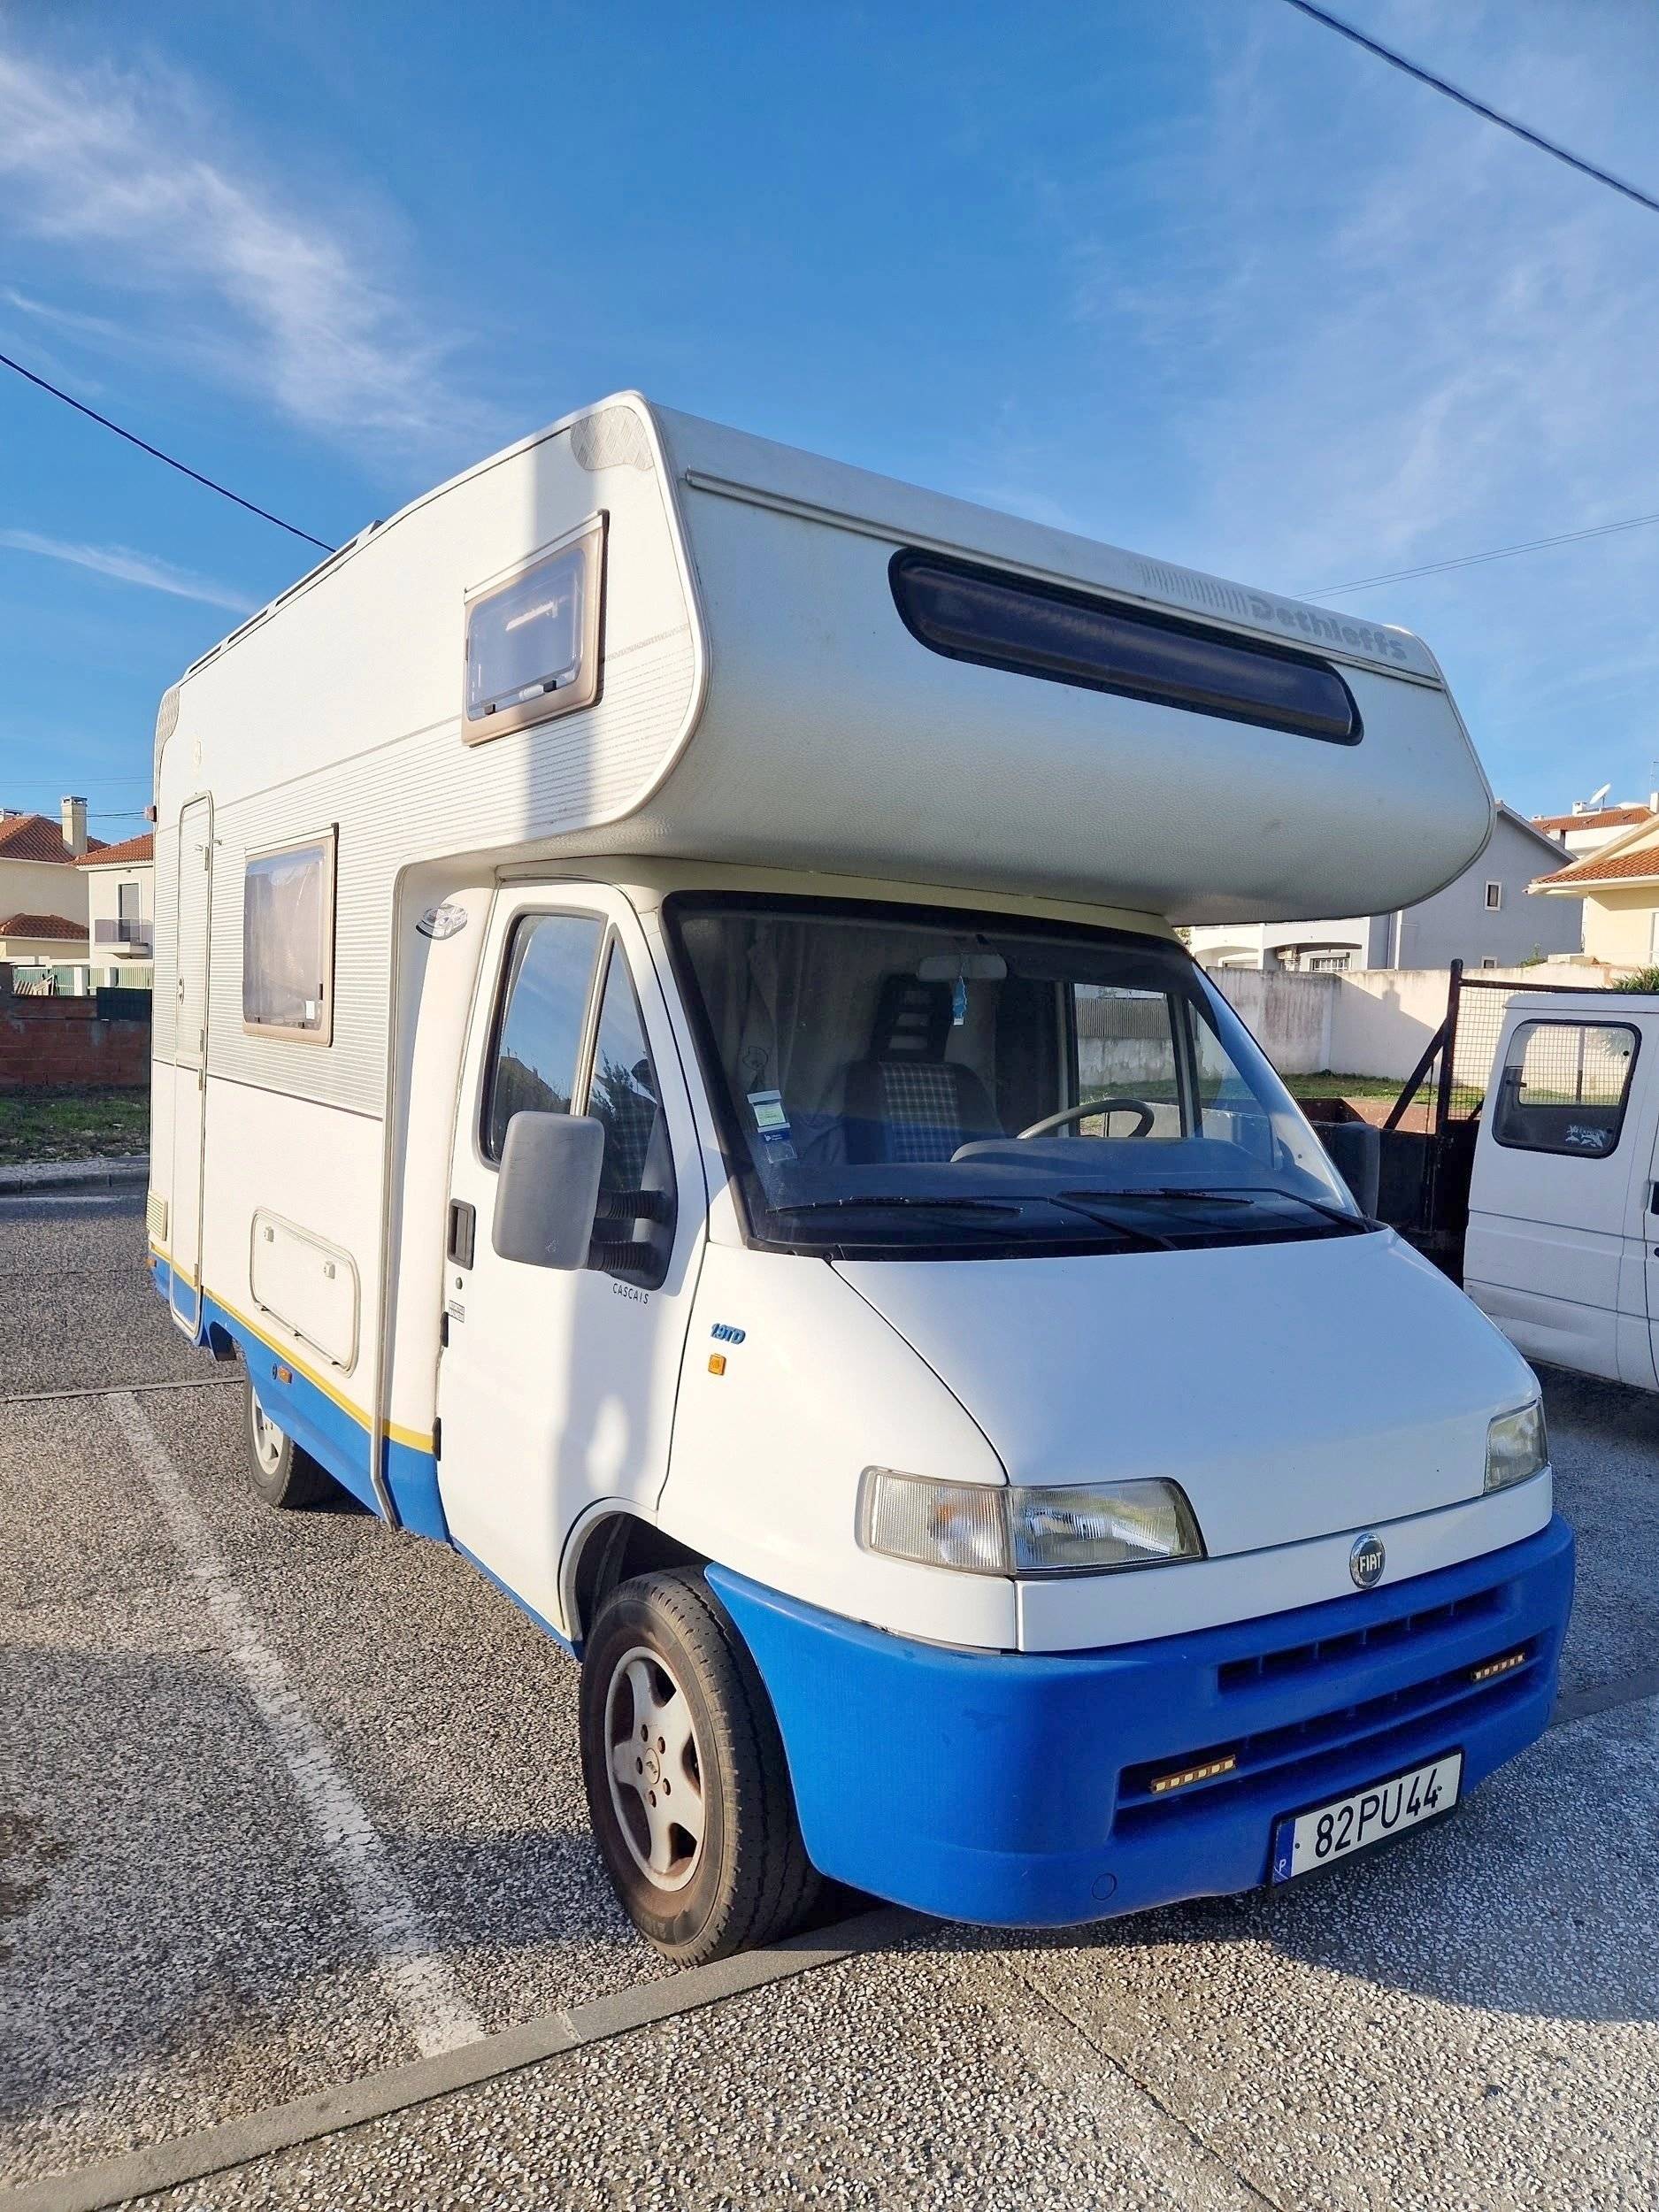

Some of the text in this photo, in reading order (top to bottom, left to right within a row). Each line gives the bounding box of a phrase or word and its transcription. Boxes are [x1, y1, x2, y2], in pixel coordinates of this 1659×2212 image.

[1248, 594, 1408, 661] Dethleffs
[612, 1283, 649, 1305] CASCAIS
[1359, 1551, 1382, 1573] FIAT
[1315, 1768, 1439, 1858] 82PU44
